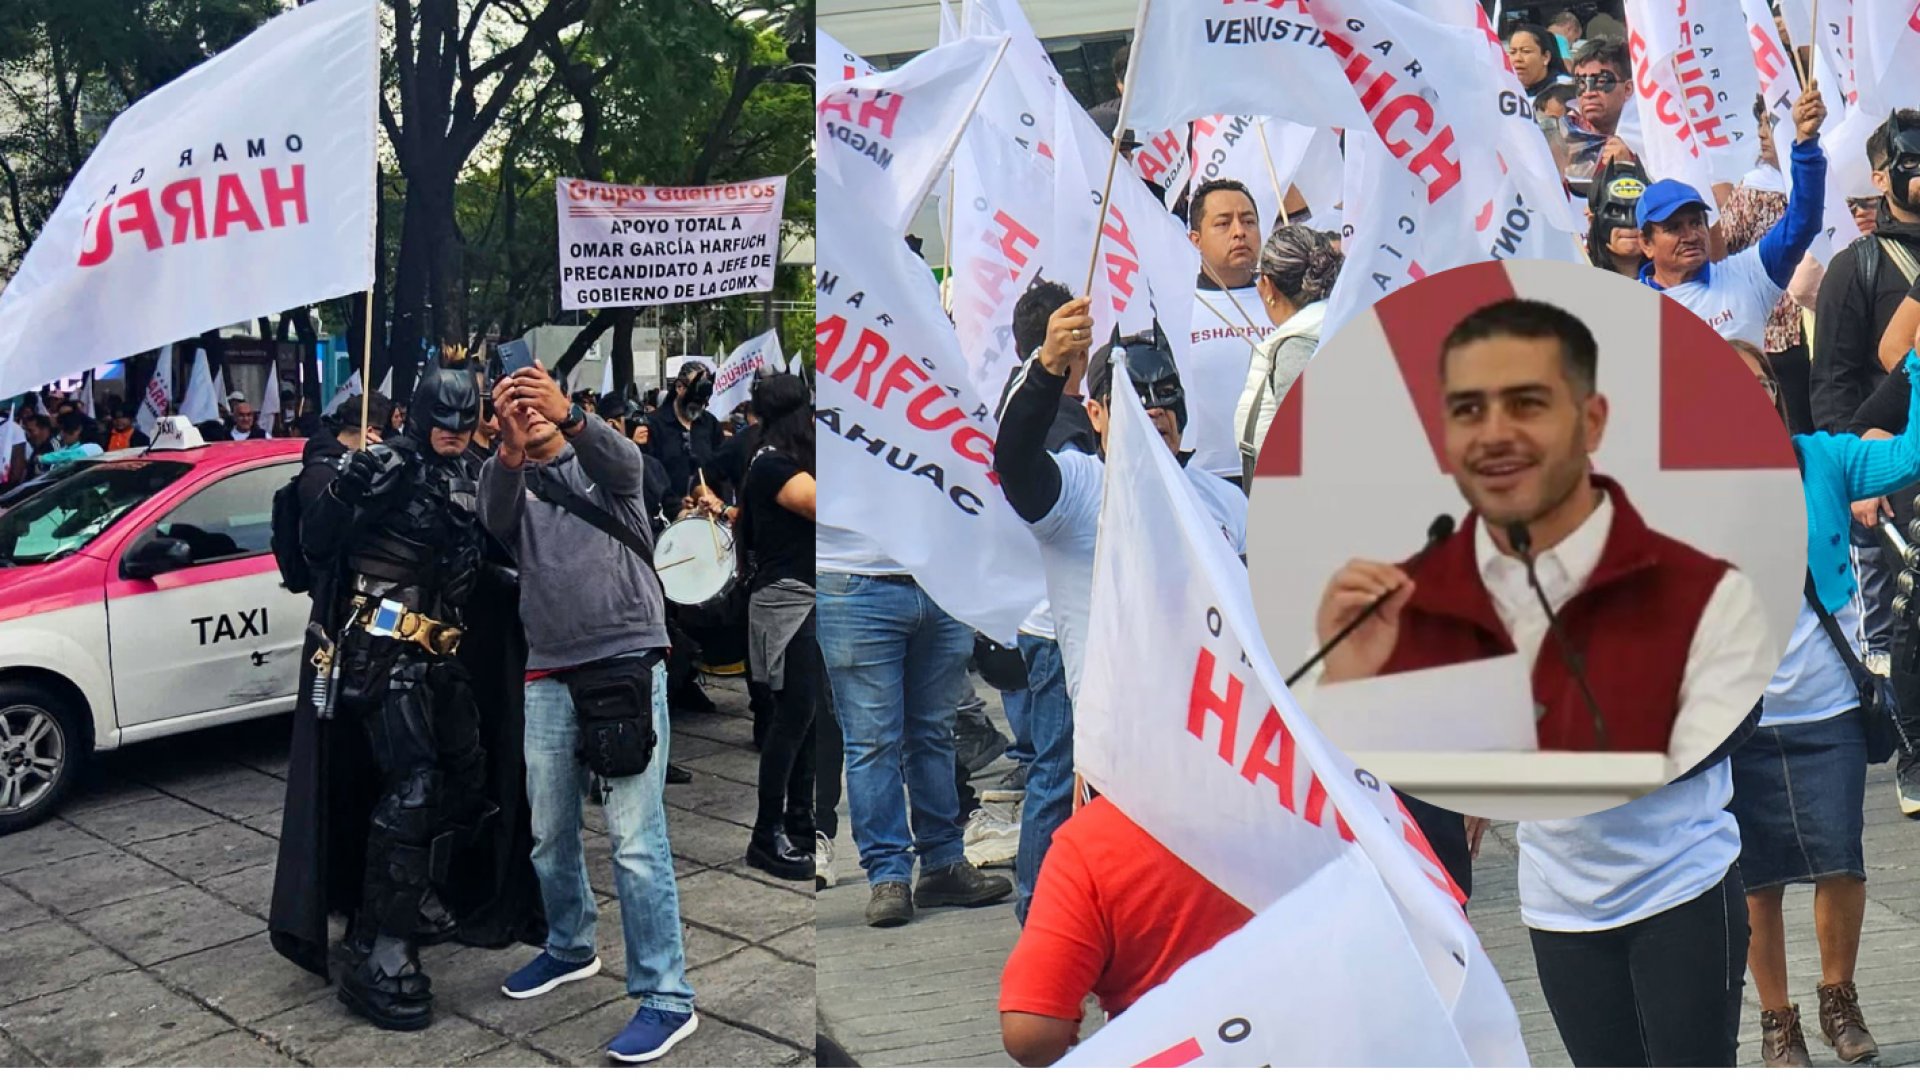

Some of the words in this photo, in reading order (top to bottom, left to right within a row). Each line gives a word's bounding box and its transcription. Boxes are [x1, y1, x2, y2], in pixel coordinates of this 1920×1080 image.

[568, 180, 647, 207] Grupo
[654, 183, 776, 202] Guerreros
[611, 219, 670, 235] APOYO
[675, 217, 726, 233] TOTAL
[731, 216, 742, 230] A
[570, 243, 625, 258] OMAR
[630, 237, 695, 257] GARCÍA
[700, 233, 767, 254] HARFUCH
[564, 262, 698, 282] PRECANDIDATO
[703, 261, 713, 275] A
[718, 256, 748, 274] JEFE
[751, 254, 771, 268] DE
[577, 285, 669, 304] GOBIERNO
[674, 284, 695, 298] DE
[700, 281, 717, 296] LA
[191, 607, 269, 646] TAXI
